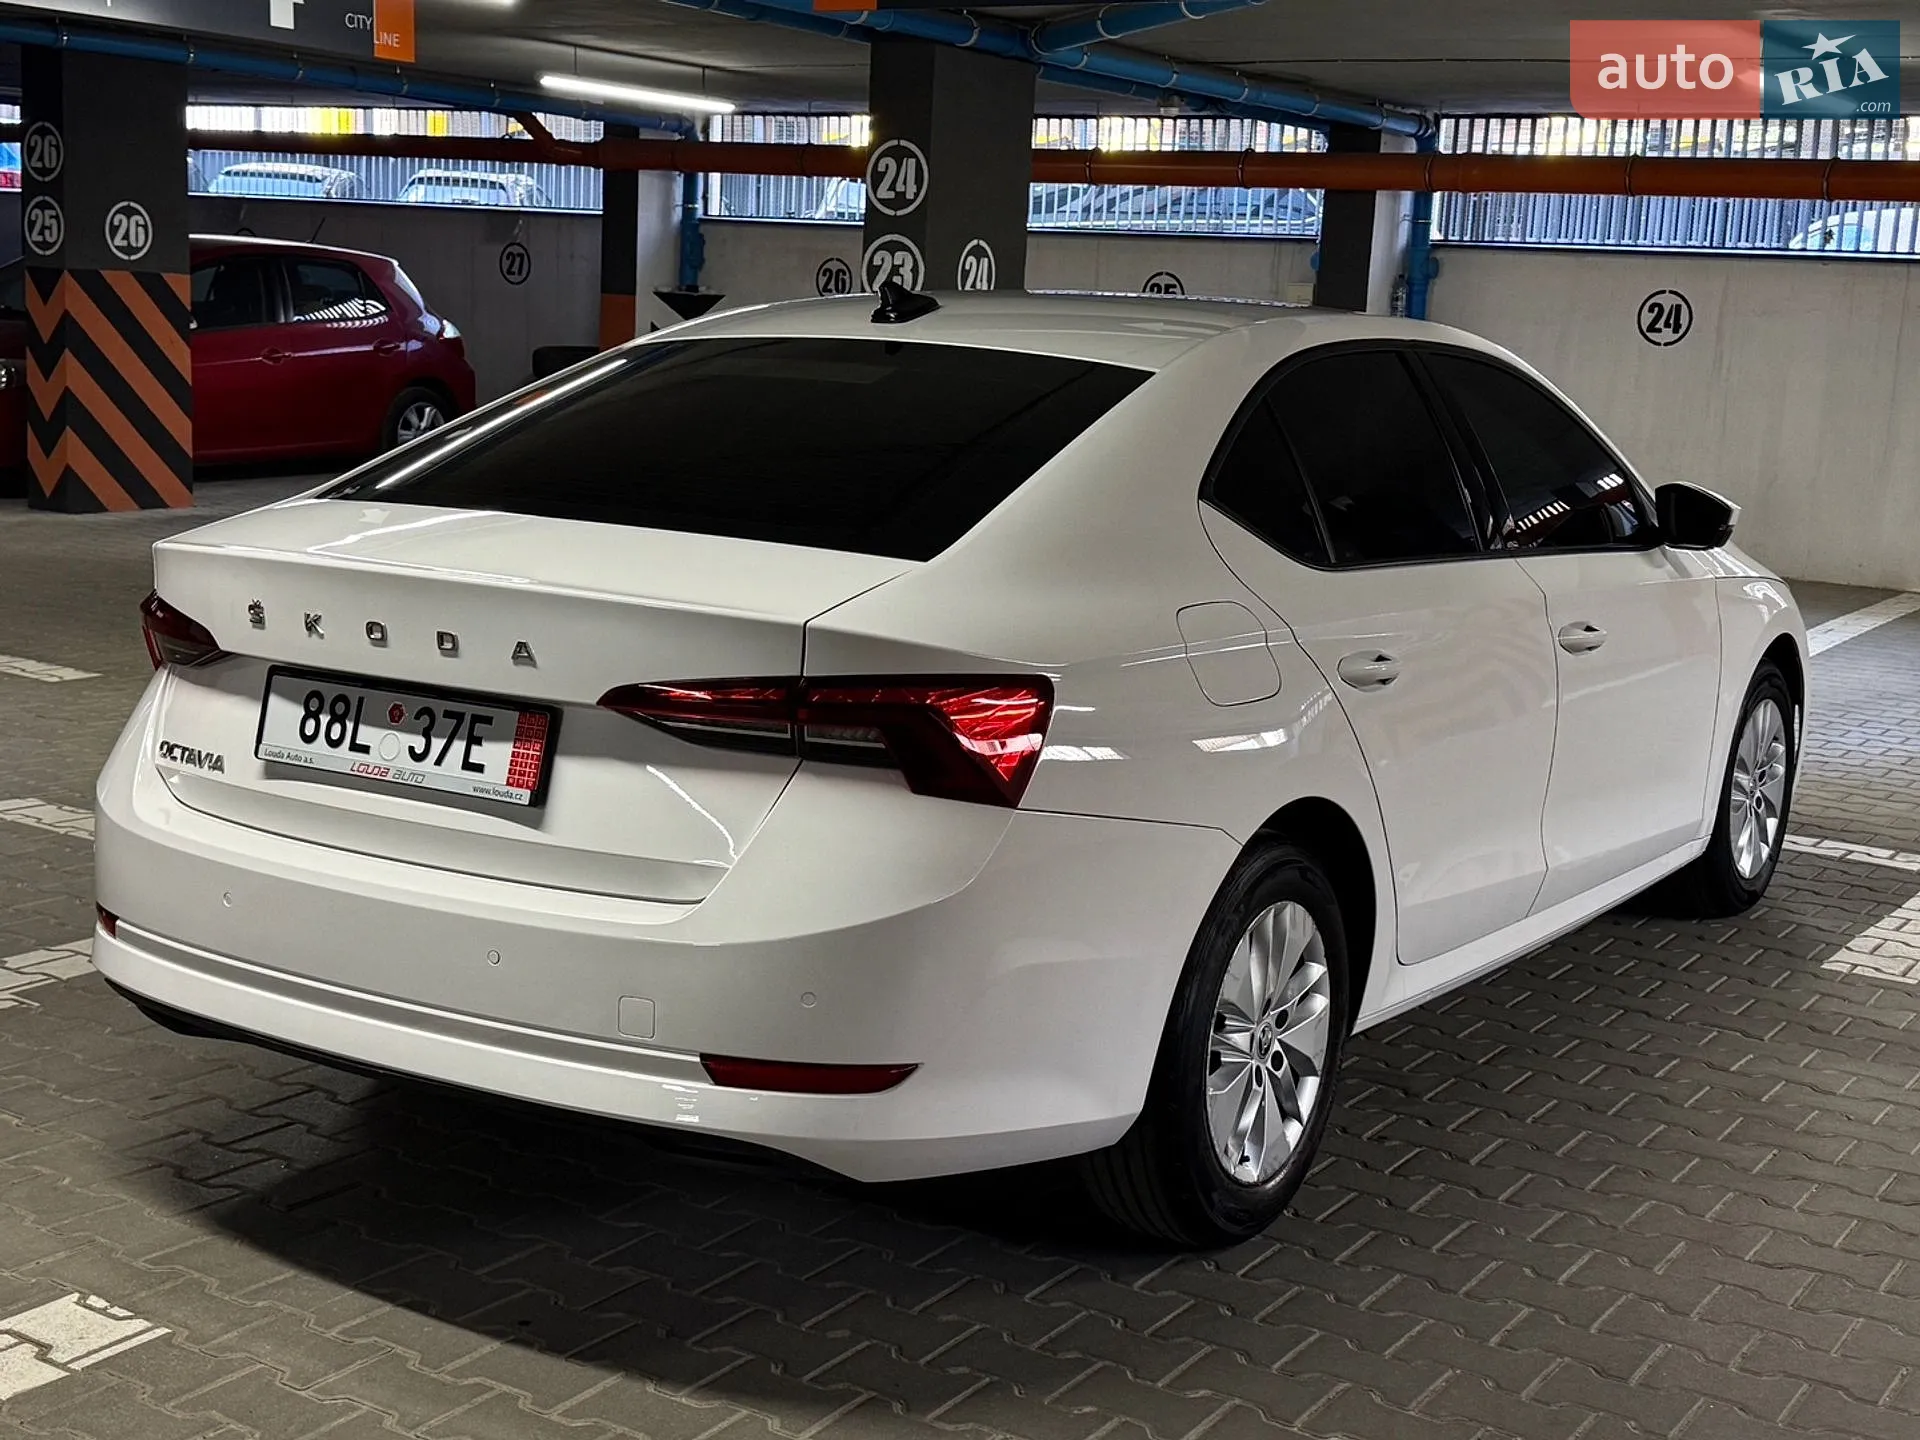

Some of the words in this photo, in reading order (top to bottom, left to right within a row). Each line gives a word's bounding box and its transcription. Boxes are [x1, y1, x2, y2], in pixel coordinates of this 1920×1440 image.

[345, 13, 373, 30] CITY
[373, 32, 401, 48] LINE
[30, 134, 57, 169] 26
[876, 157, 917, 199] 24
[30, 208, 58, 243] 25
[113, 213, 146, 248] 26
[506, 251, 525, 276] 27
[821, 267, 847, 294] 26
[872, 251, 915, 291] 23
[964, 256, 988, 290] 24
[1646, 302, 1682, 334] 24
[298, 689, 371, 755] 88L
[408, 706, 494, 774] 37E
[159, 740, 225, 774] OCTAVIA
[285, 751, 302, 764] Auto
[472, 784, 524, 801] www.louda.cz
